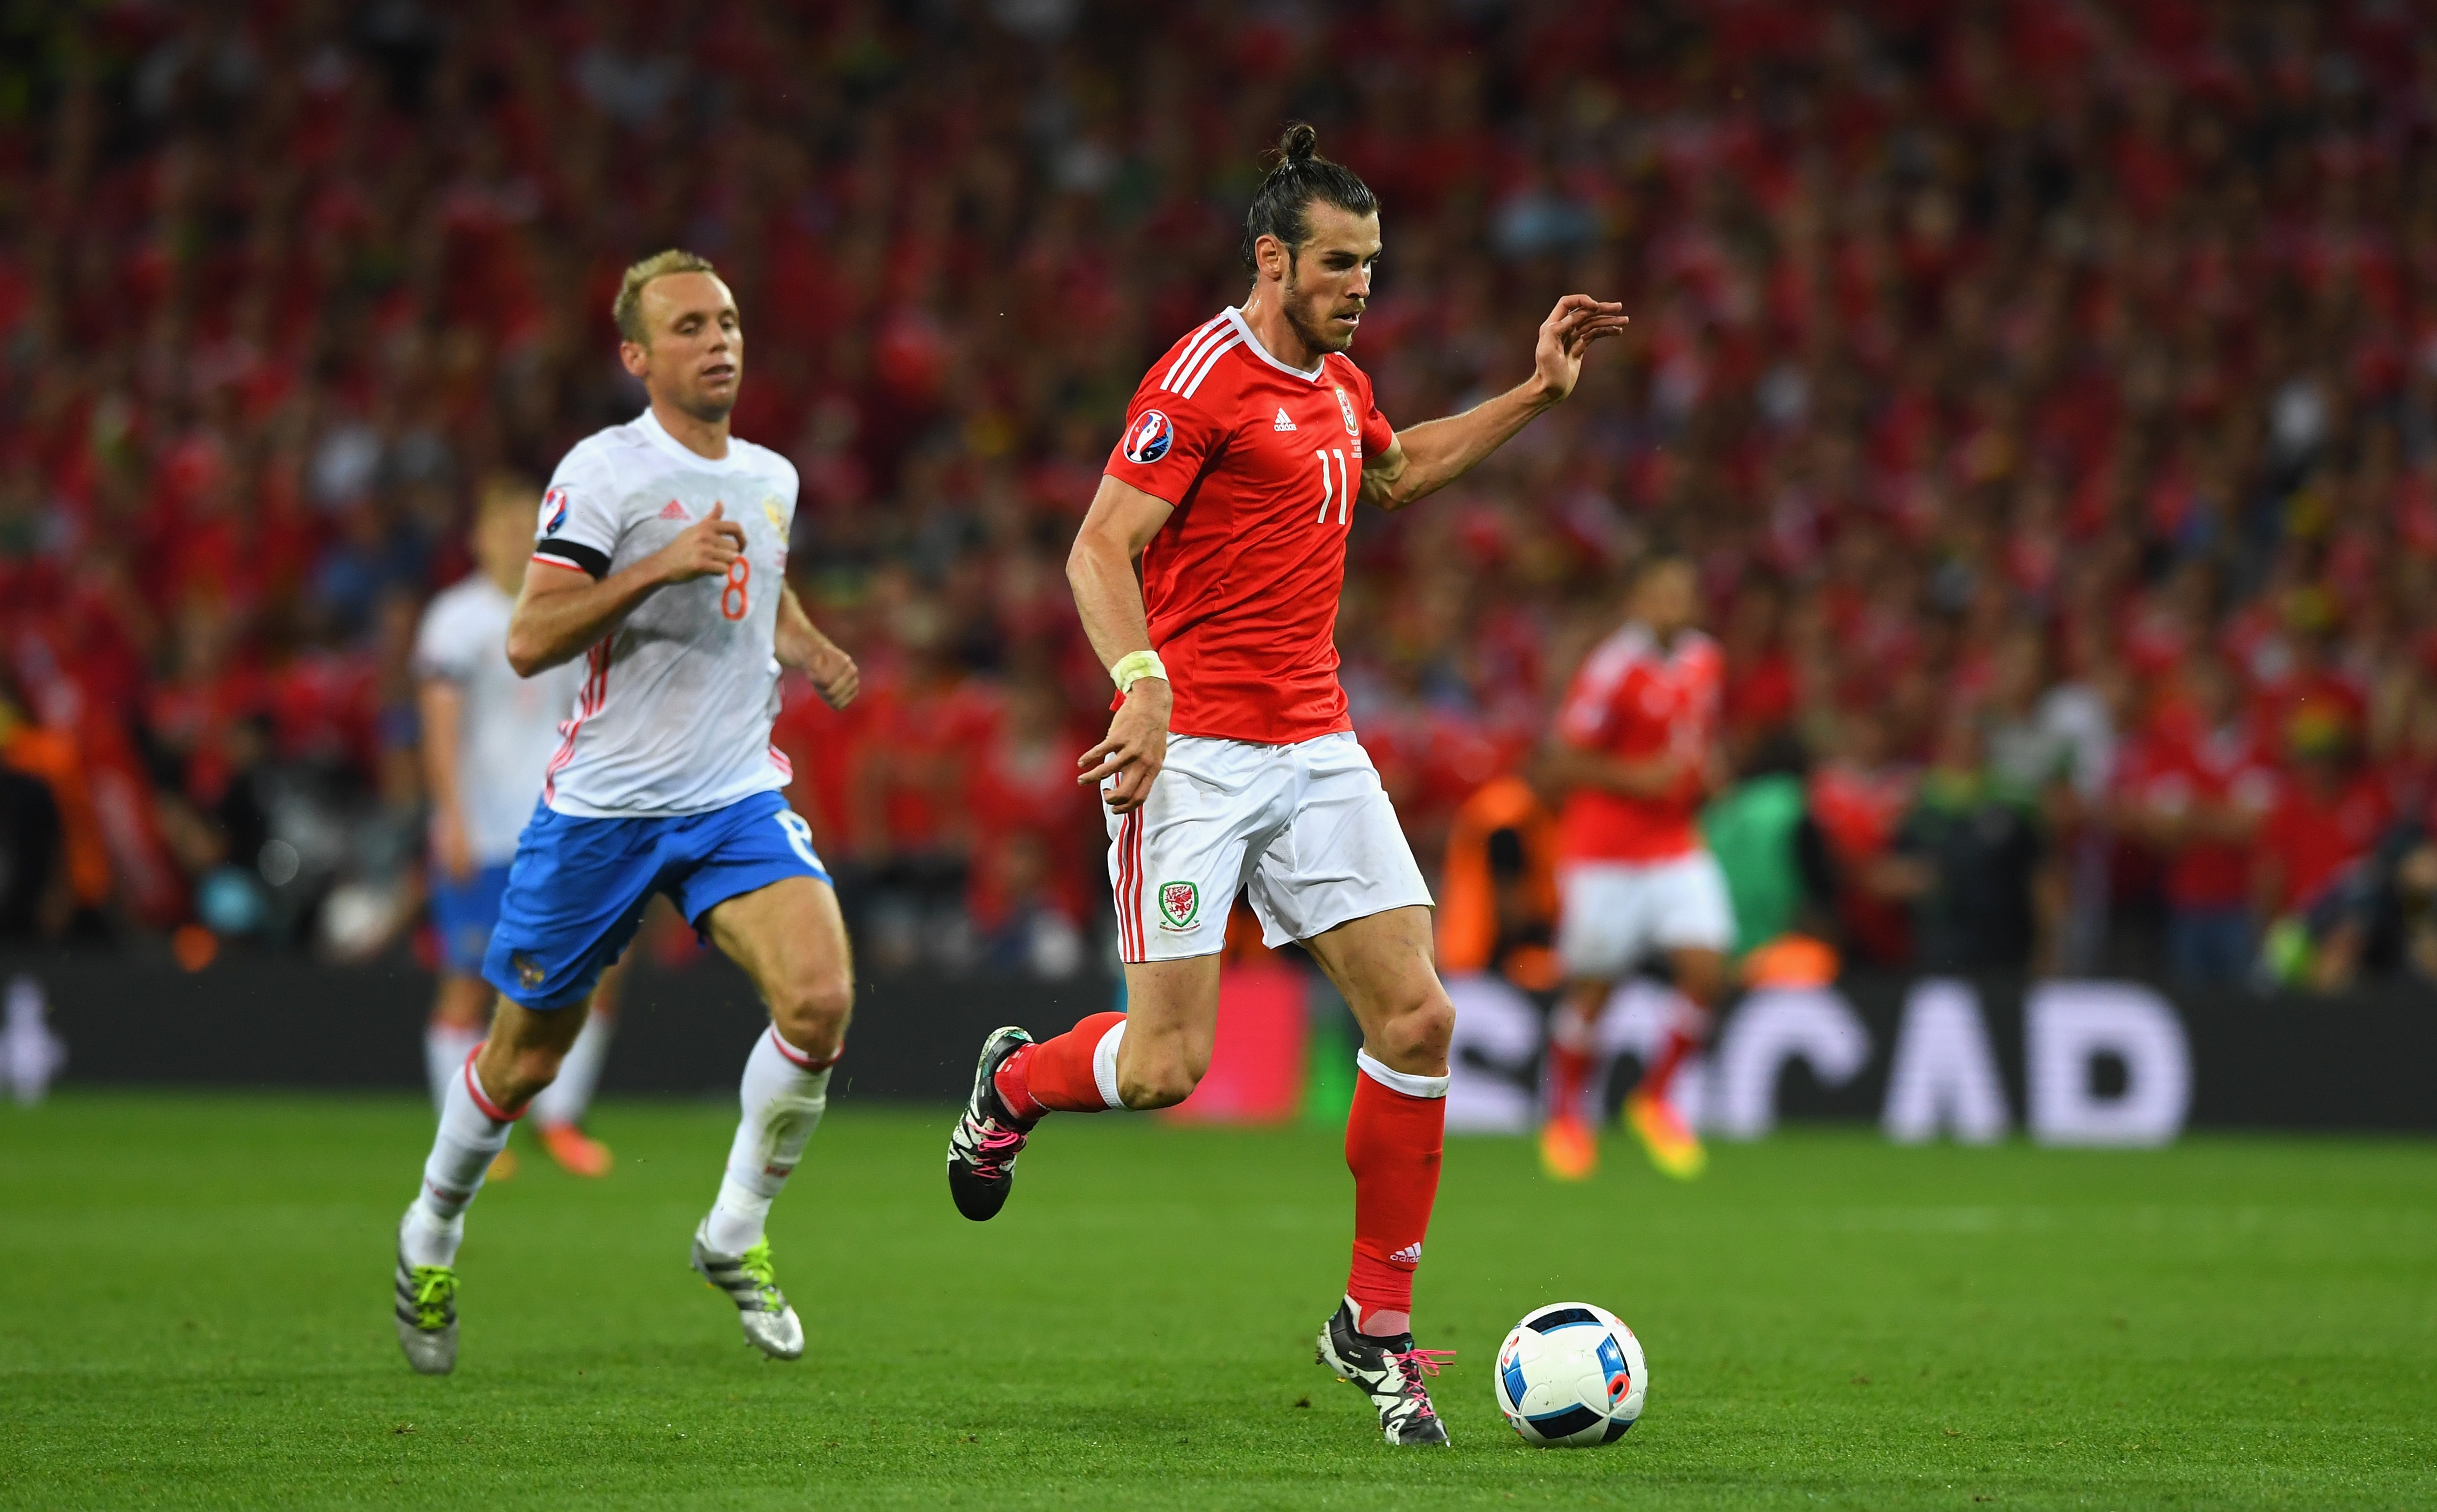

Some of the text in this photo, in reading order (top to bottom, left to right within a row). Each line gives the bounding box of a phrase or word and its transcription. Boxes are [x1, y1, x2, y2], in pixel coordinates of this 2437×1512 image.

[1274, 422, 1297, 432] adidas
[1316, 449, 1346, 525] 11
[721, 555, 750, 621] 8
